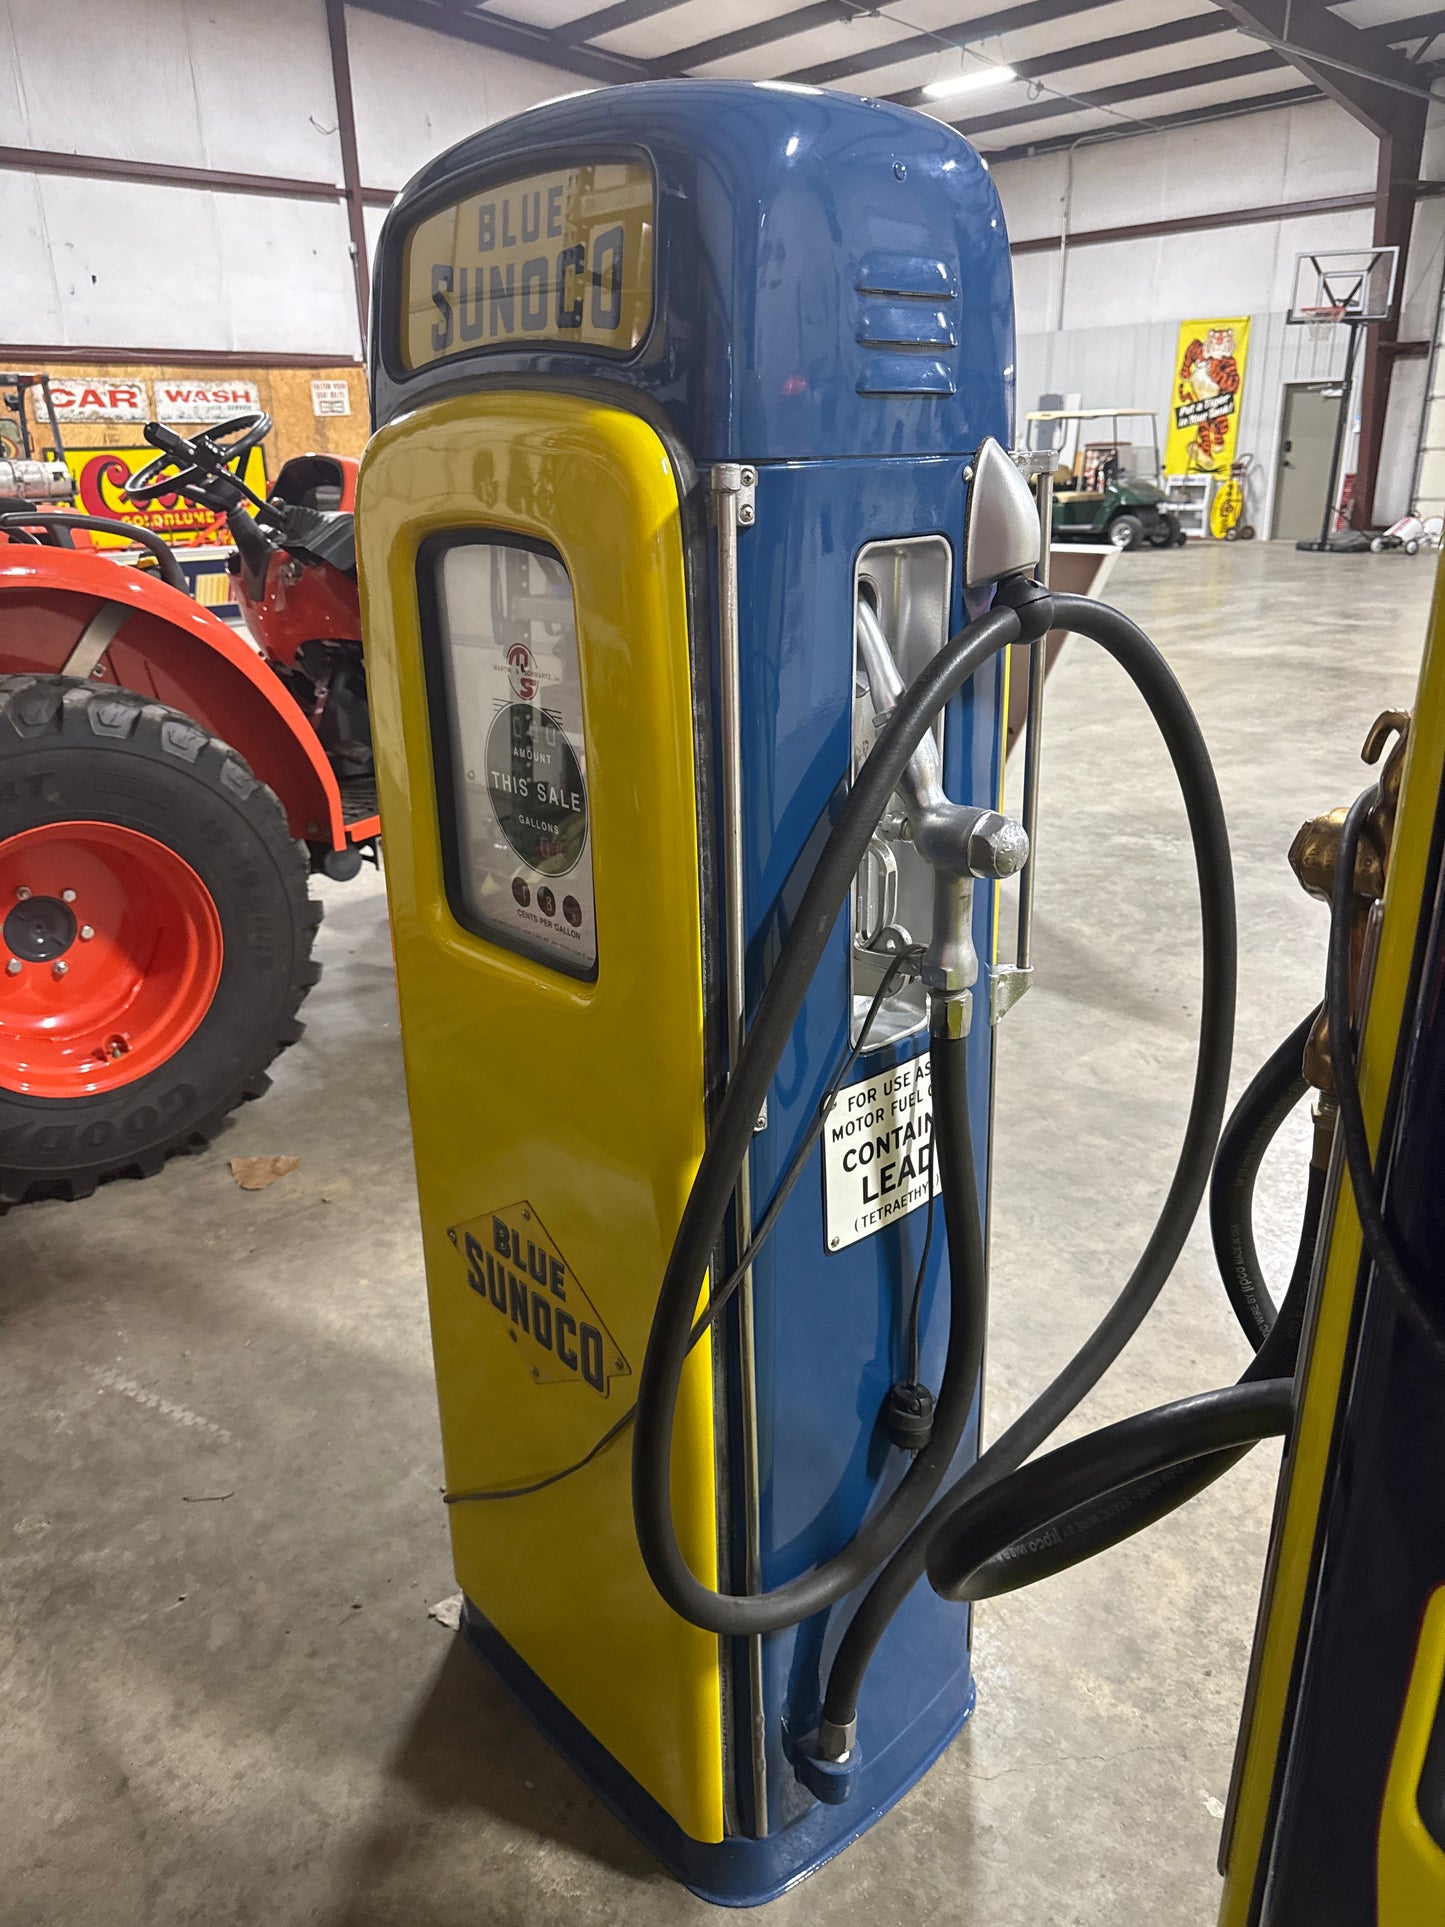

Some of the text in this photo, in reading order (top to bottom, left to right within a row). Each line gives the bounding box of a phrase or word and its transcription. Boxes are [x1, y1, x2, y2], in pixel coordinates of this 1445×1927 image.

[478, 184, 563, 253] BLUE
[431, 225, 624, 352] SUNOCO
[43, 388, 252, 408] CAR WASH
[512, 747, 552, 765] AMOUNT
[491, 770, 581, 813] THIS SALE
[518, 814, 560, 836] GALLONS
[517, 908, 538, 924] CENTS
[539, 917, 553, 929] PER
[554, 922, 581, 941] GALLON
[847, 1087, 877, 1113] FOR
[883, 1071, 911, 1096] USE
[915, 1061, 931, 1082] AS
[832, 1091, 923, 1143] MOTOR FUEL
[862, 1145, 931, 1205] LEAD
[492, 1214, 566, 1303] BLUE
[465, 1231, 604, 1394] SUNOCO
